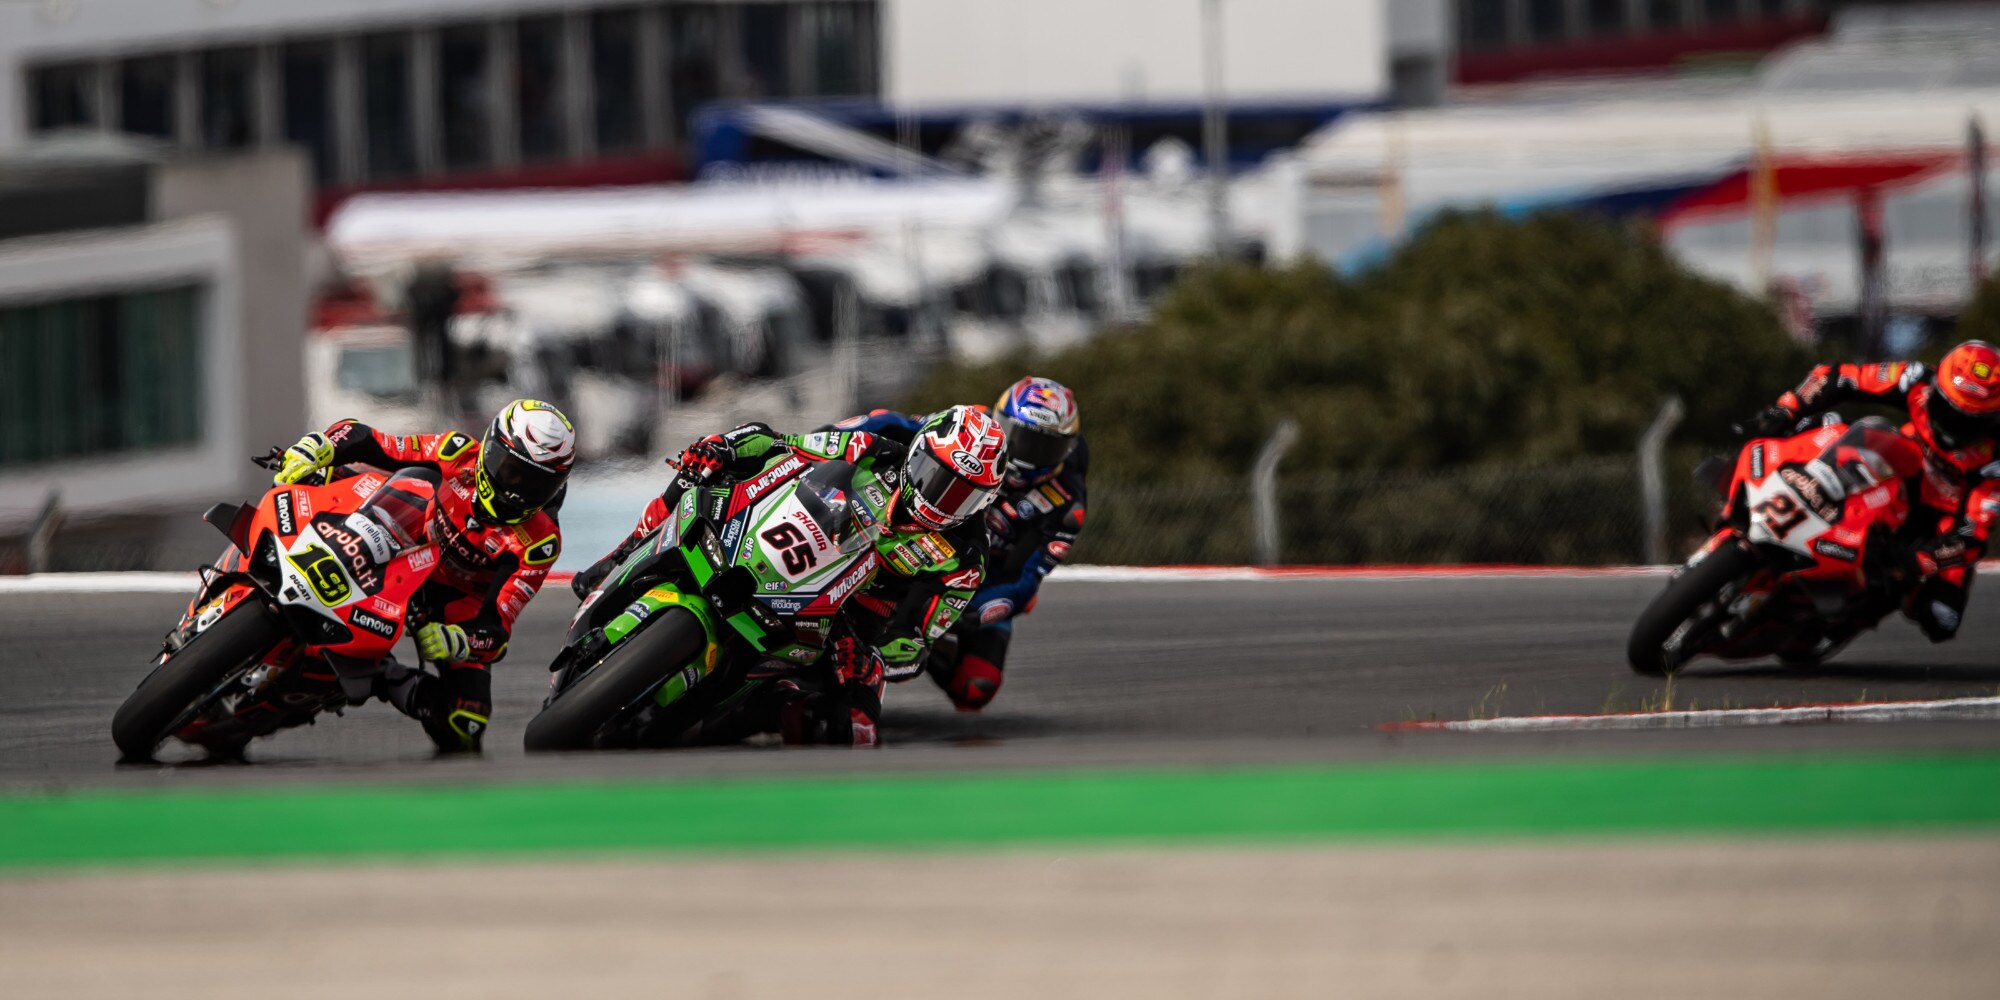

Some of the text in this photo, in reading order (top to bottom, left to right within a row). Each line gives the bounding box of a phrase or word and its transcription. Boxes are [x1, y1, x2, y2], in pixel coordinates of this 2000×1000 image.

[959, 453, 983, 474] Arai
[851, 500, 867, 516] elf
[868, 488, 885, 508] Arai
[277, 493, 291, 533] Lenovo
[1753, 493, 1809, 540] 21
[362, 521, 381, 544] riello
[792, 511, 827, 551] SHOWA
[316, 521, 378, 590] aruba.it
[744, 536, 755, 554] elf
[761, 521, 817, 576] 65
[895, 545, 920, 568] SHOWA
[285, 542, 352, 607] 19
[764, 580, 779, 590] elf
[289, 574, 312, 601] DUCATI
[945, 597, 967, 609] elf
[352, 609, 394, 636] Lenovo
